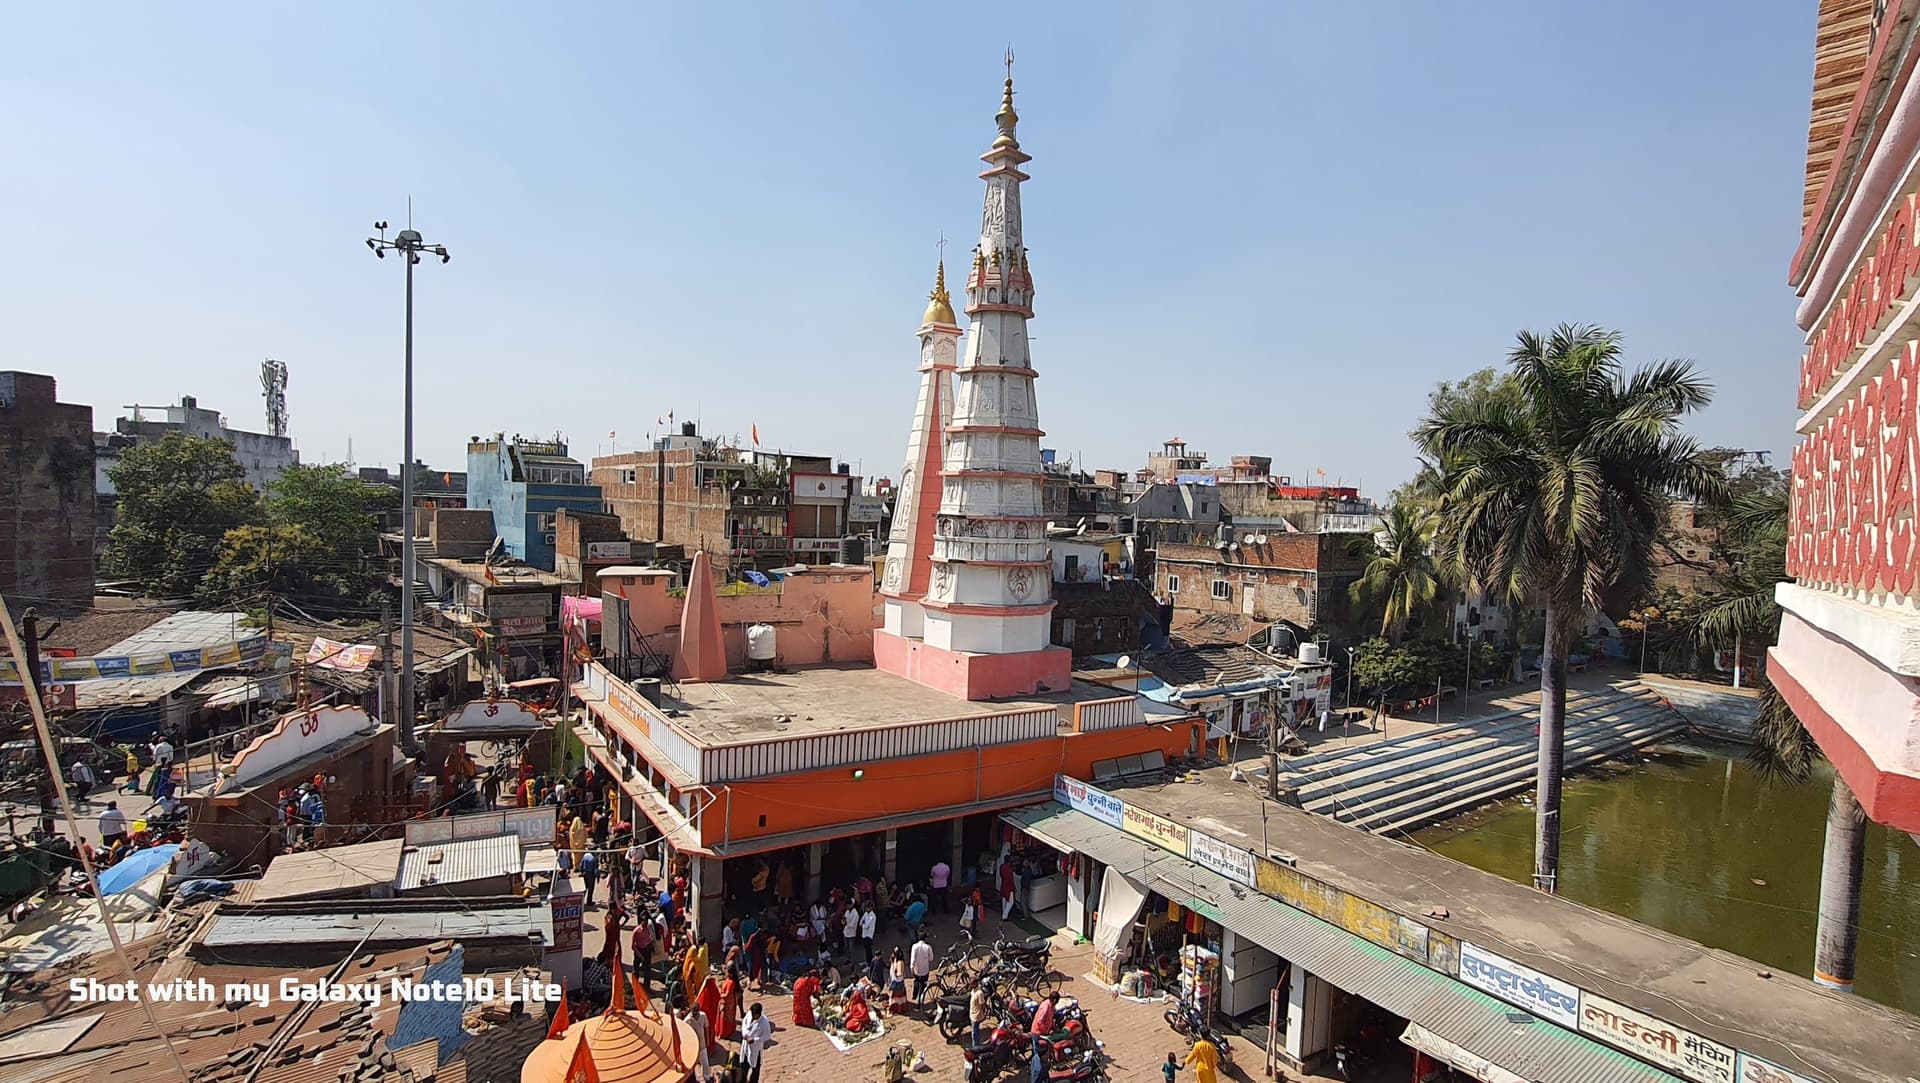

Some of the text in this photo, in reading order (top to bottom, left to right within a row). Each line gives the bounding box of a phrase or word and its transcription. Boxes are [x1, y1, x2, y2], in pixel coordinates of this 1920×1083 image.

[1462, 952, 1521, 991] दुपट्टा
[1520, 977, 1577, 1015] सेंटर
[1584, 1003, 1681, 1055] लाडली
